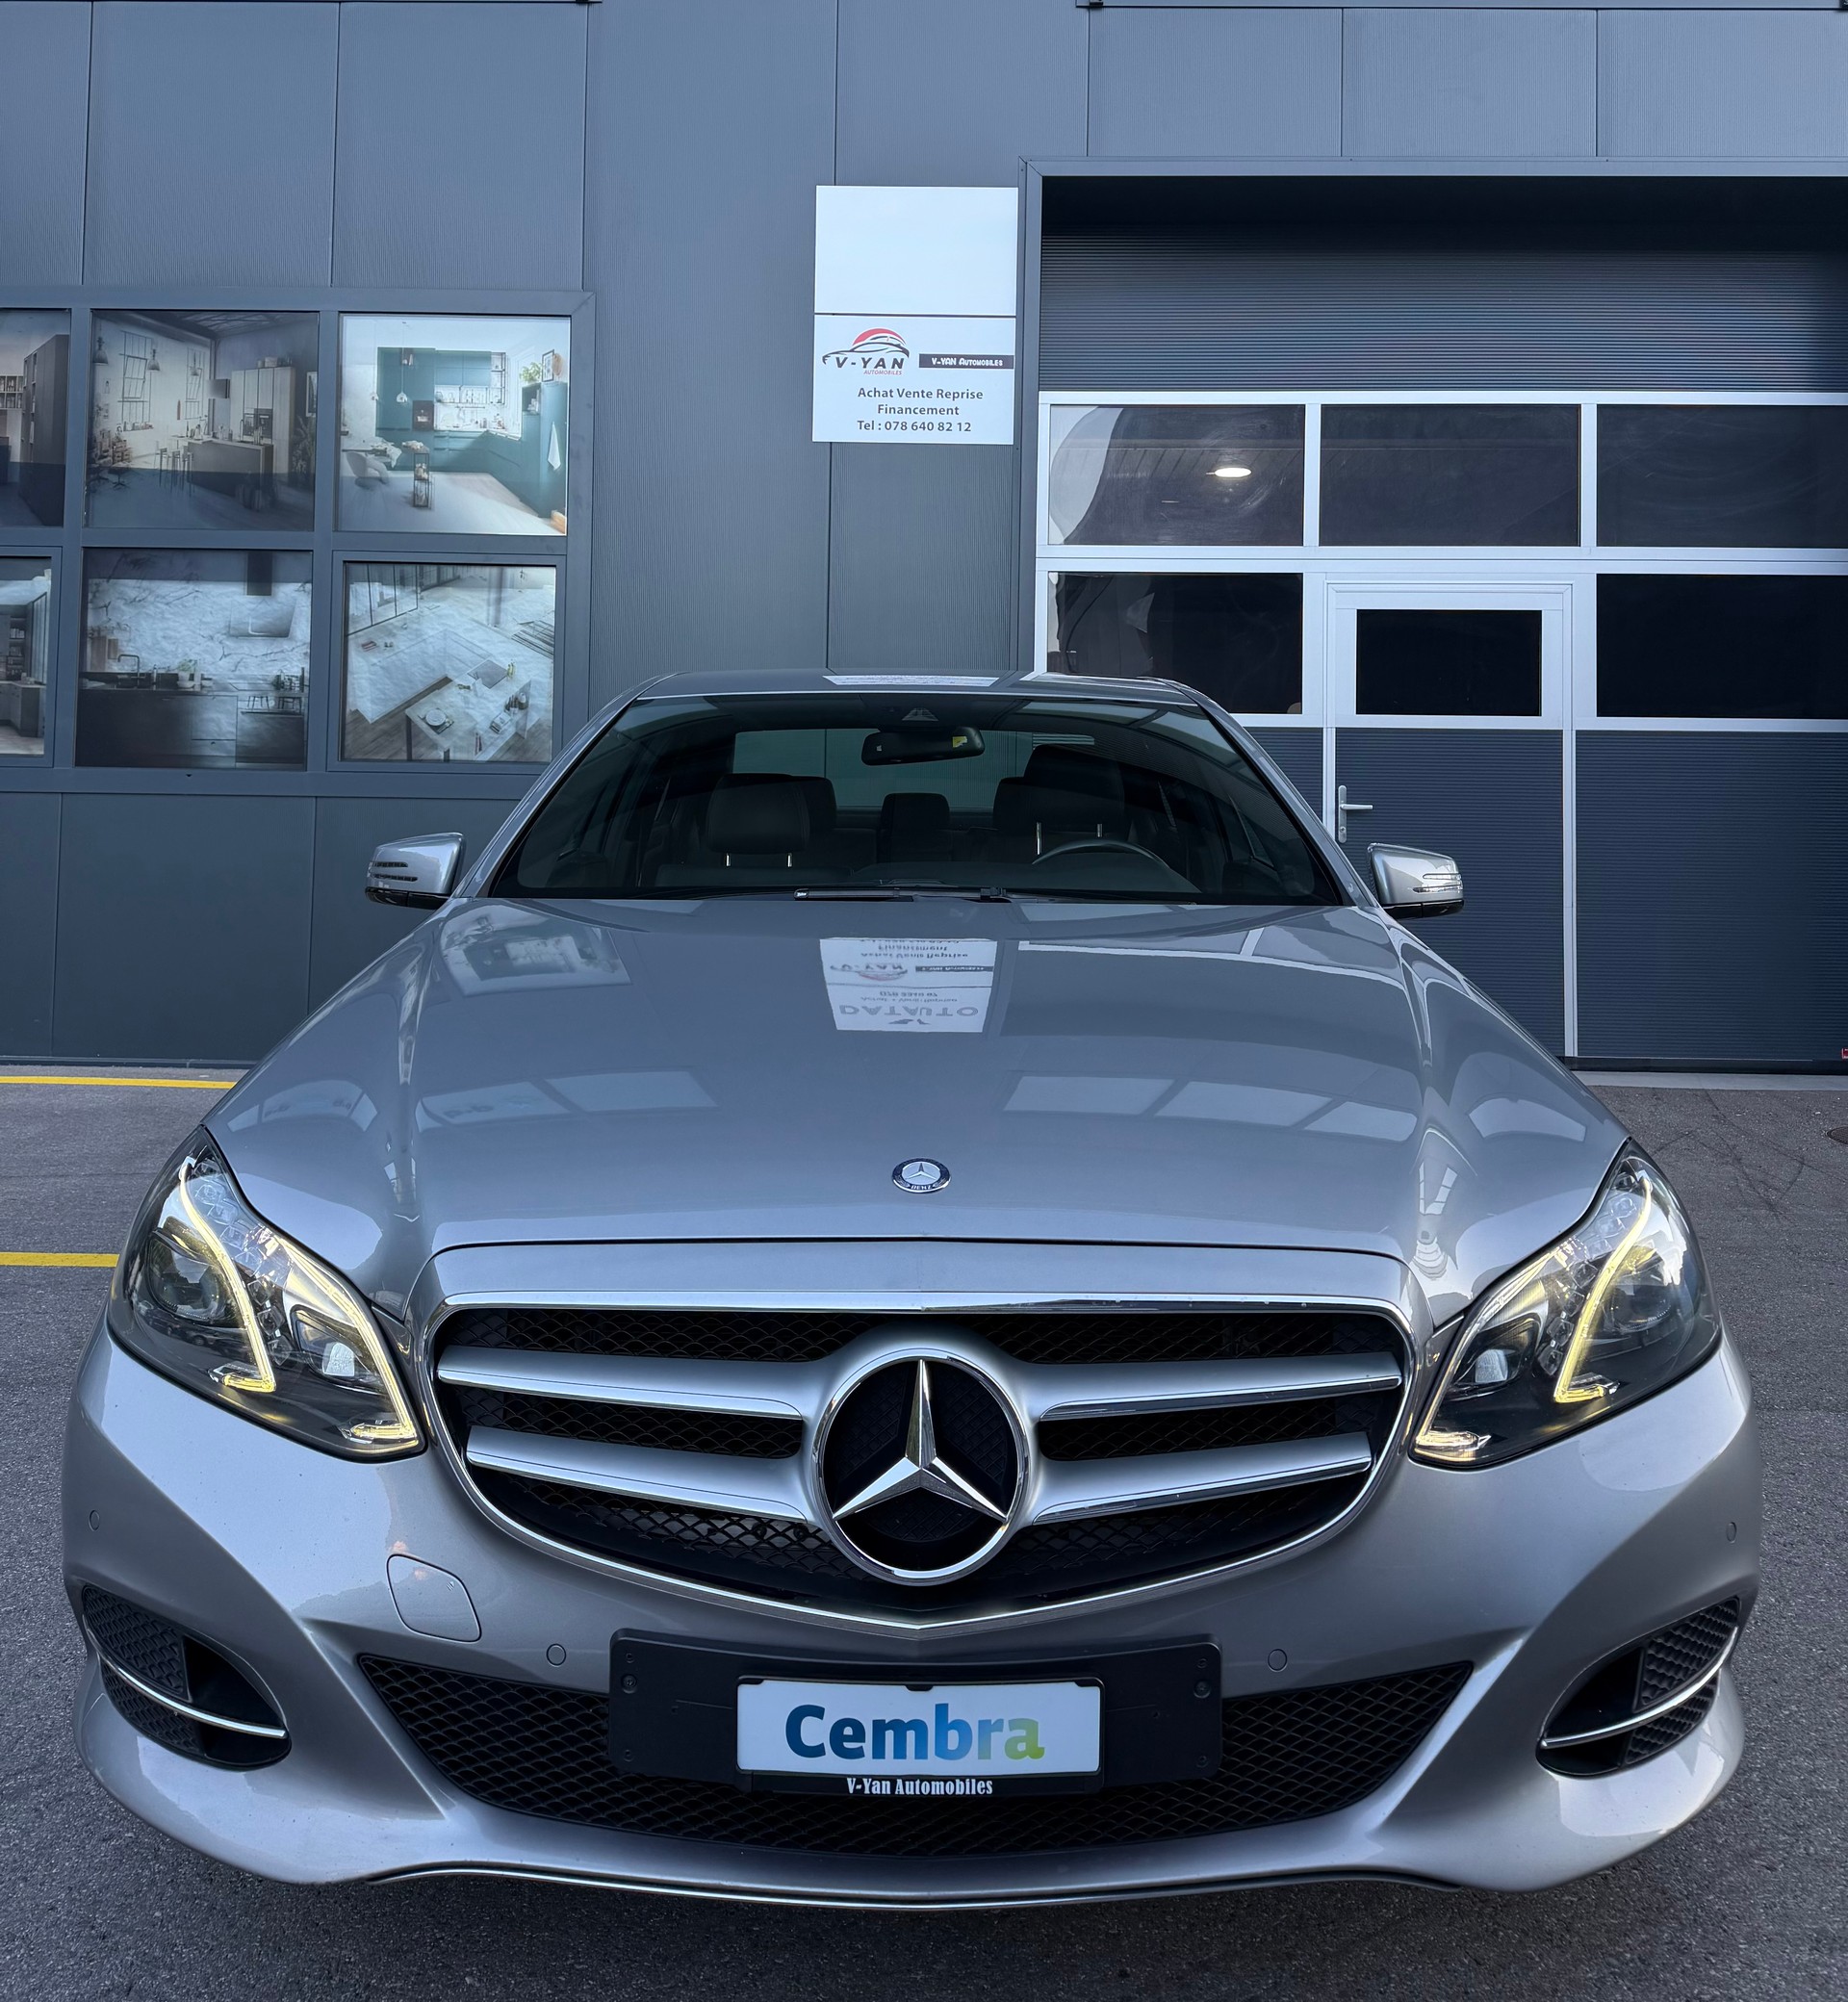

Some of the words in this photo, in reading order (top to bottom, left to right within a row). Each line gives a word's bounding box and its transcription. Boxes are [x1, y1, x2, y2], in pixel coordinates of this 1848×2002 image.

[835, 356, 905, 370] V-YAN
[932, 357, 957, 366] V-YAN
[858, 387, 894, 398] Achat
[897, 388, 934, 398] Vente
[937, 389, 984, 401] Reprise
[877, 403, 960, 415] Financement
[885, 421, 908, 431] 078
[911, 421, 935, 431] 640
[937, 422, 953, 432] 82
[957, 422, 971, 432] 12
[784, 1703, 1045, 1760] Cembra
[846, 1777, 891, 1795] V-Yan
[895, 1778, 993, 1795] Automobiles
